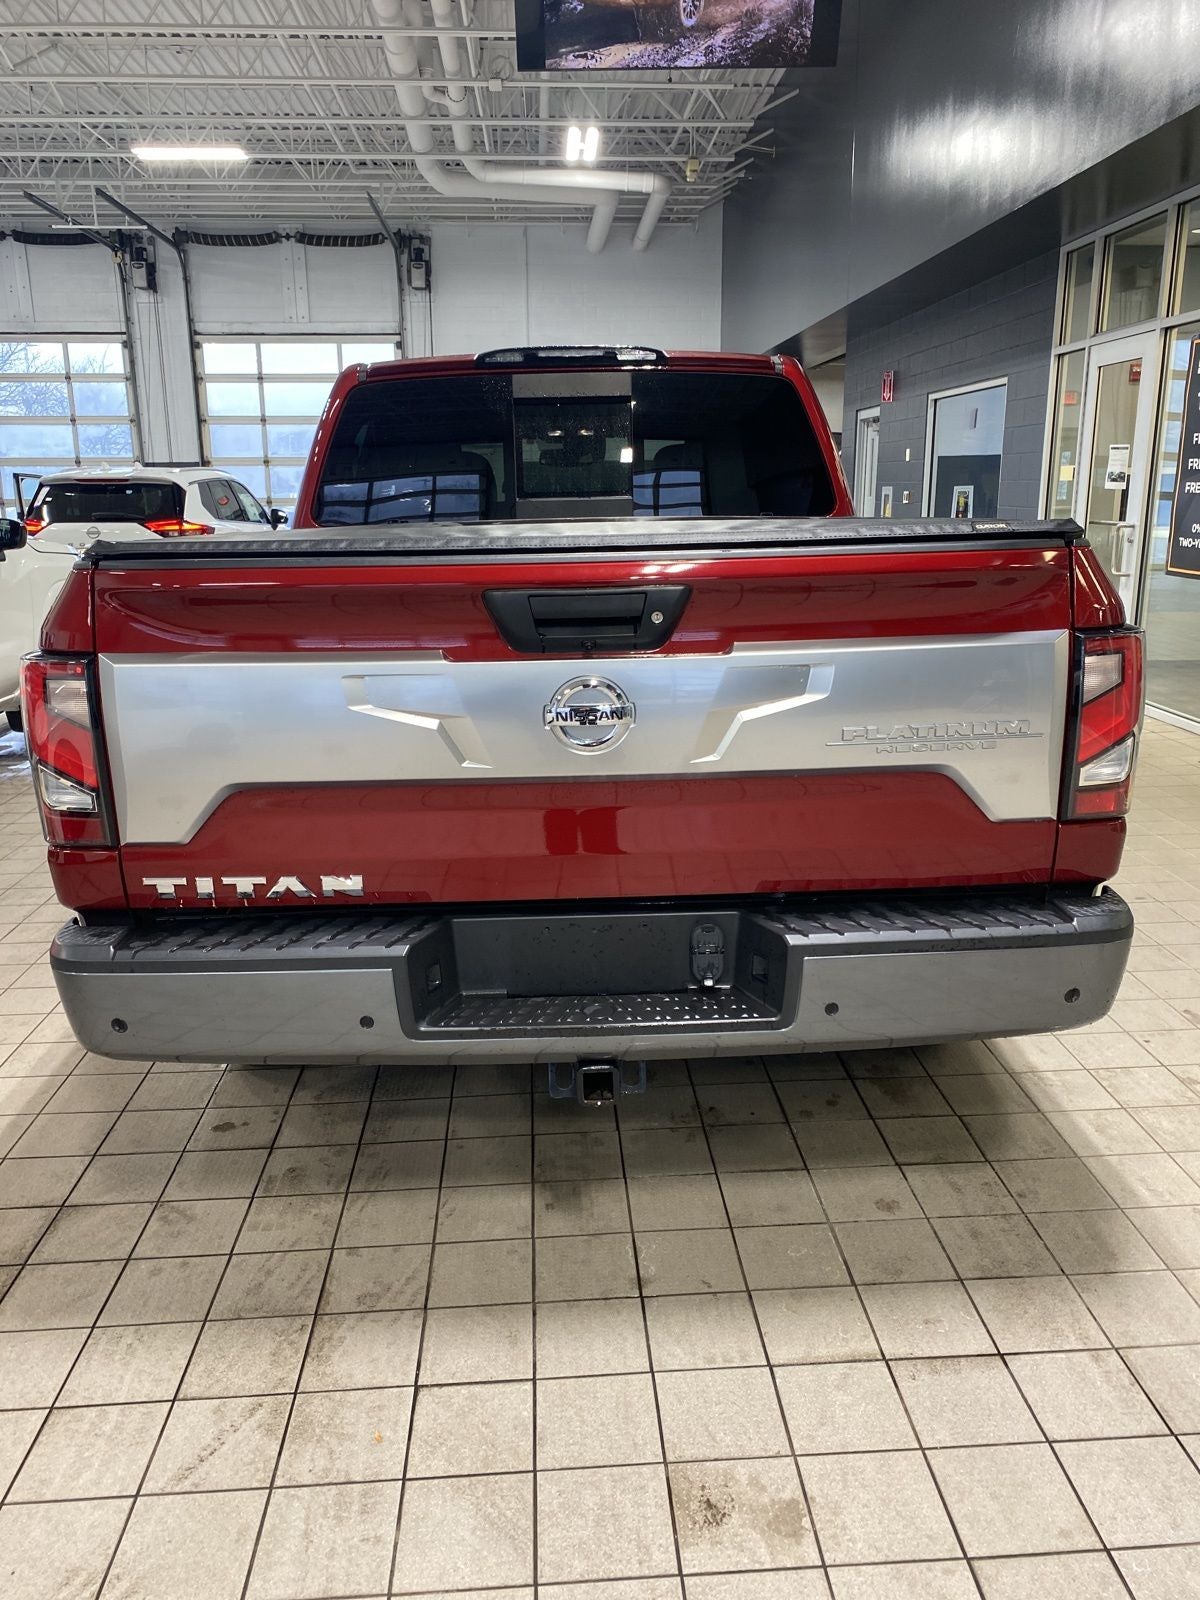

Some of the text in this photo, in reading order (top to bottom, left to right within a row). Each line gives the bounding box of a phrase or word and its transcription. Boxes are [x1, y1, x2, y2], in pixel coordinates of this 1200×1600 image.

[555, 710, 624, 722] NISSAN
[841, 720, 1031, 742] PLATINUM
[876, 740, 998, 753] RESERVE
[142, 874, 364, 899] TITAN
